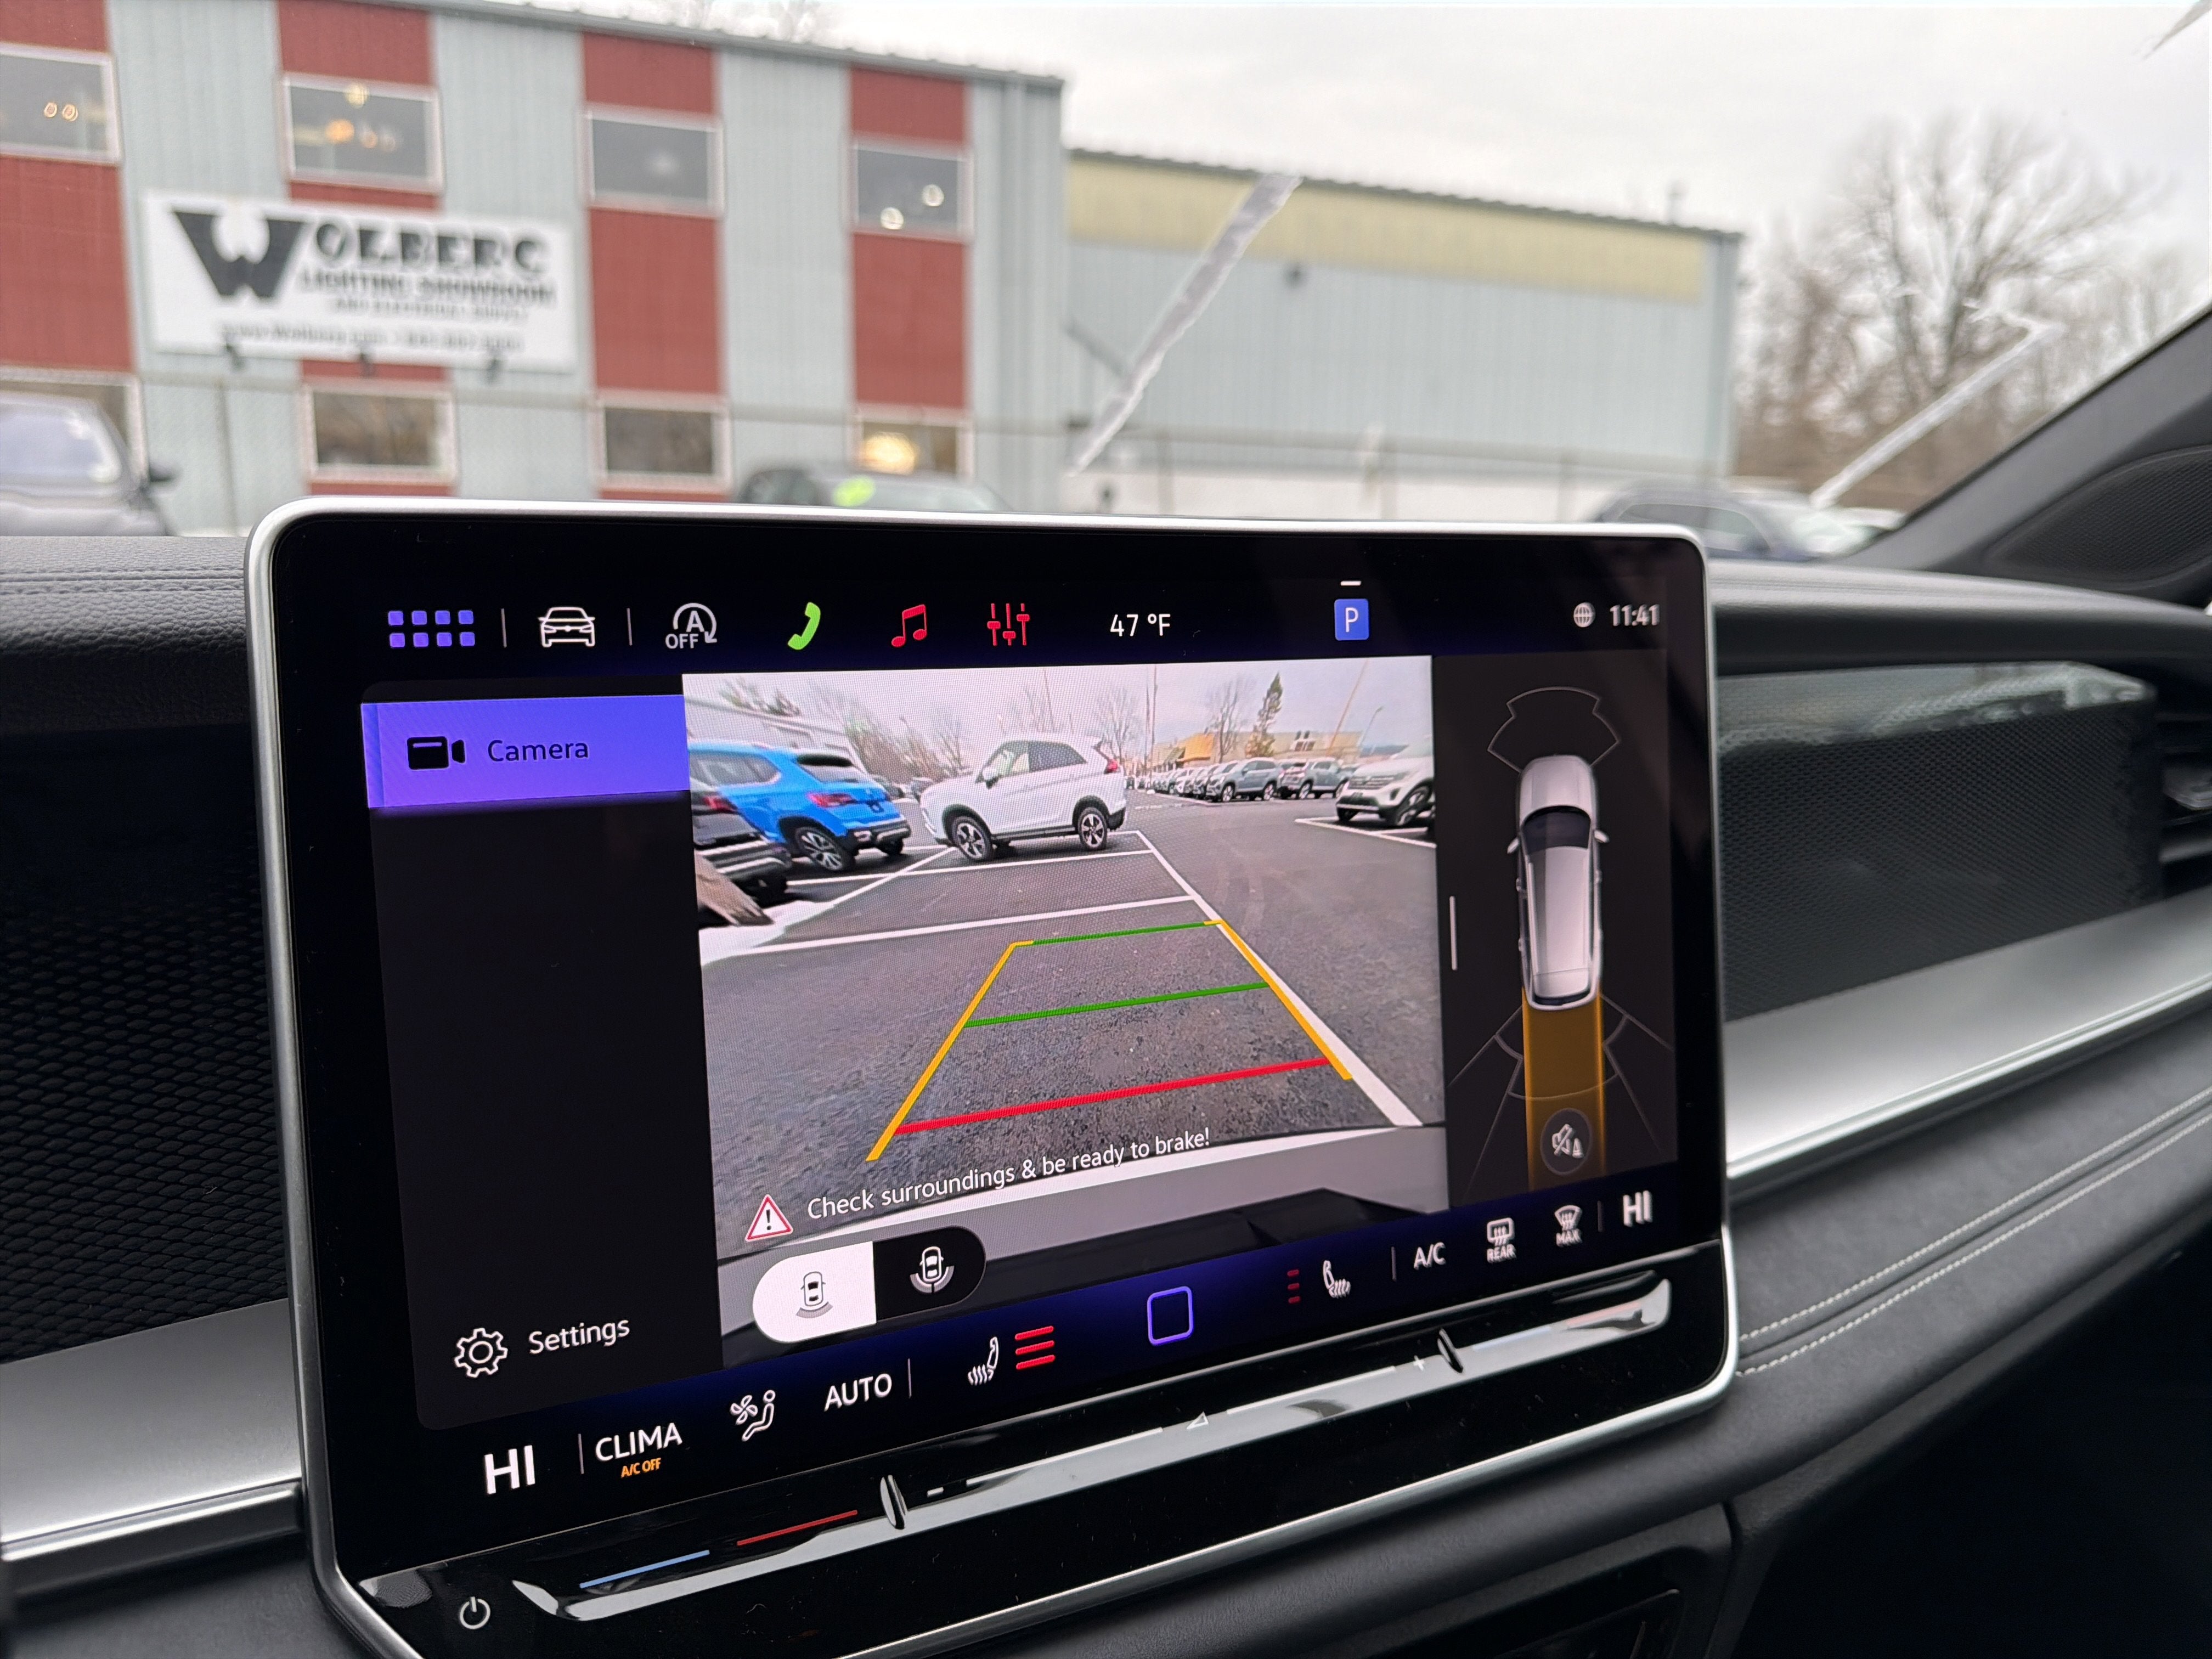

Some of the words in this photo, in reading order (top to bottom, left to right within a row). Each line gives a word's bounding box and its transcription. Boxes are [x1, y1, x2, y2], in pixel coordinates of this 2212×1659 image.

[1110, 614, 1138, 637] 47
[1345, 607, 1359, 633] P
[1610, 604, 1660, 627] 11:41
[665, 633, 699, 649] OFF
[487, 740, 589, 761] Camera
[808, 1189, 874, 1219] Check
[881, 1167, 1015, 1206] surroundings
[1022, 1159, 1036, 1179] &
[1042, 1156, 1066, 1176] be
[1072, 1144, 1125, 1167] ready
[1130, 1142, 1149, 1159] to
[1155, 1127, 1210, 1154] brake!
[1622, 1190, 1652, 1227] HI
[1556, 1228, 1583, 1247] MAX
[1413, 1242, 1446, 1269] A/C
[1487, 1244, 1516, 1263] REAR
[528, 1319, 630, 1355] Settings
[823, 1373, 892, 1412] AUTO
[595, 1423, 683, 1462] CLIMA
[483, 1444, 536, 1495] HI
[620, 1462, 641, 1478] A/C
[641, 1457, 662, 1472] OFF
